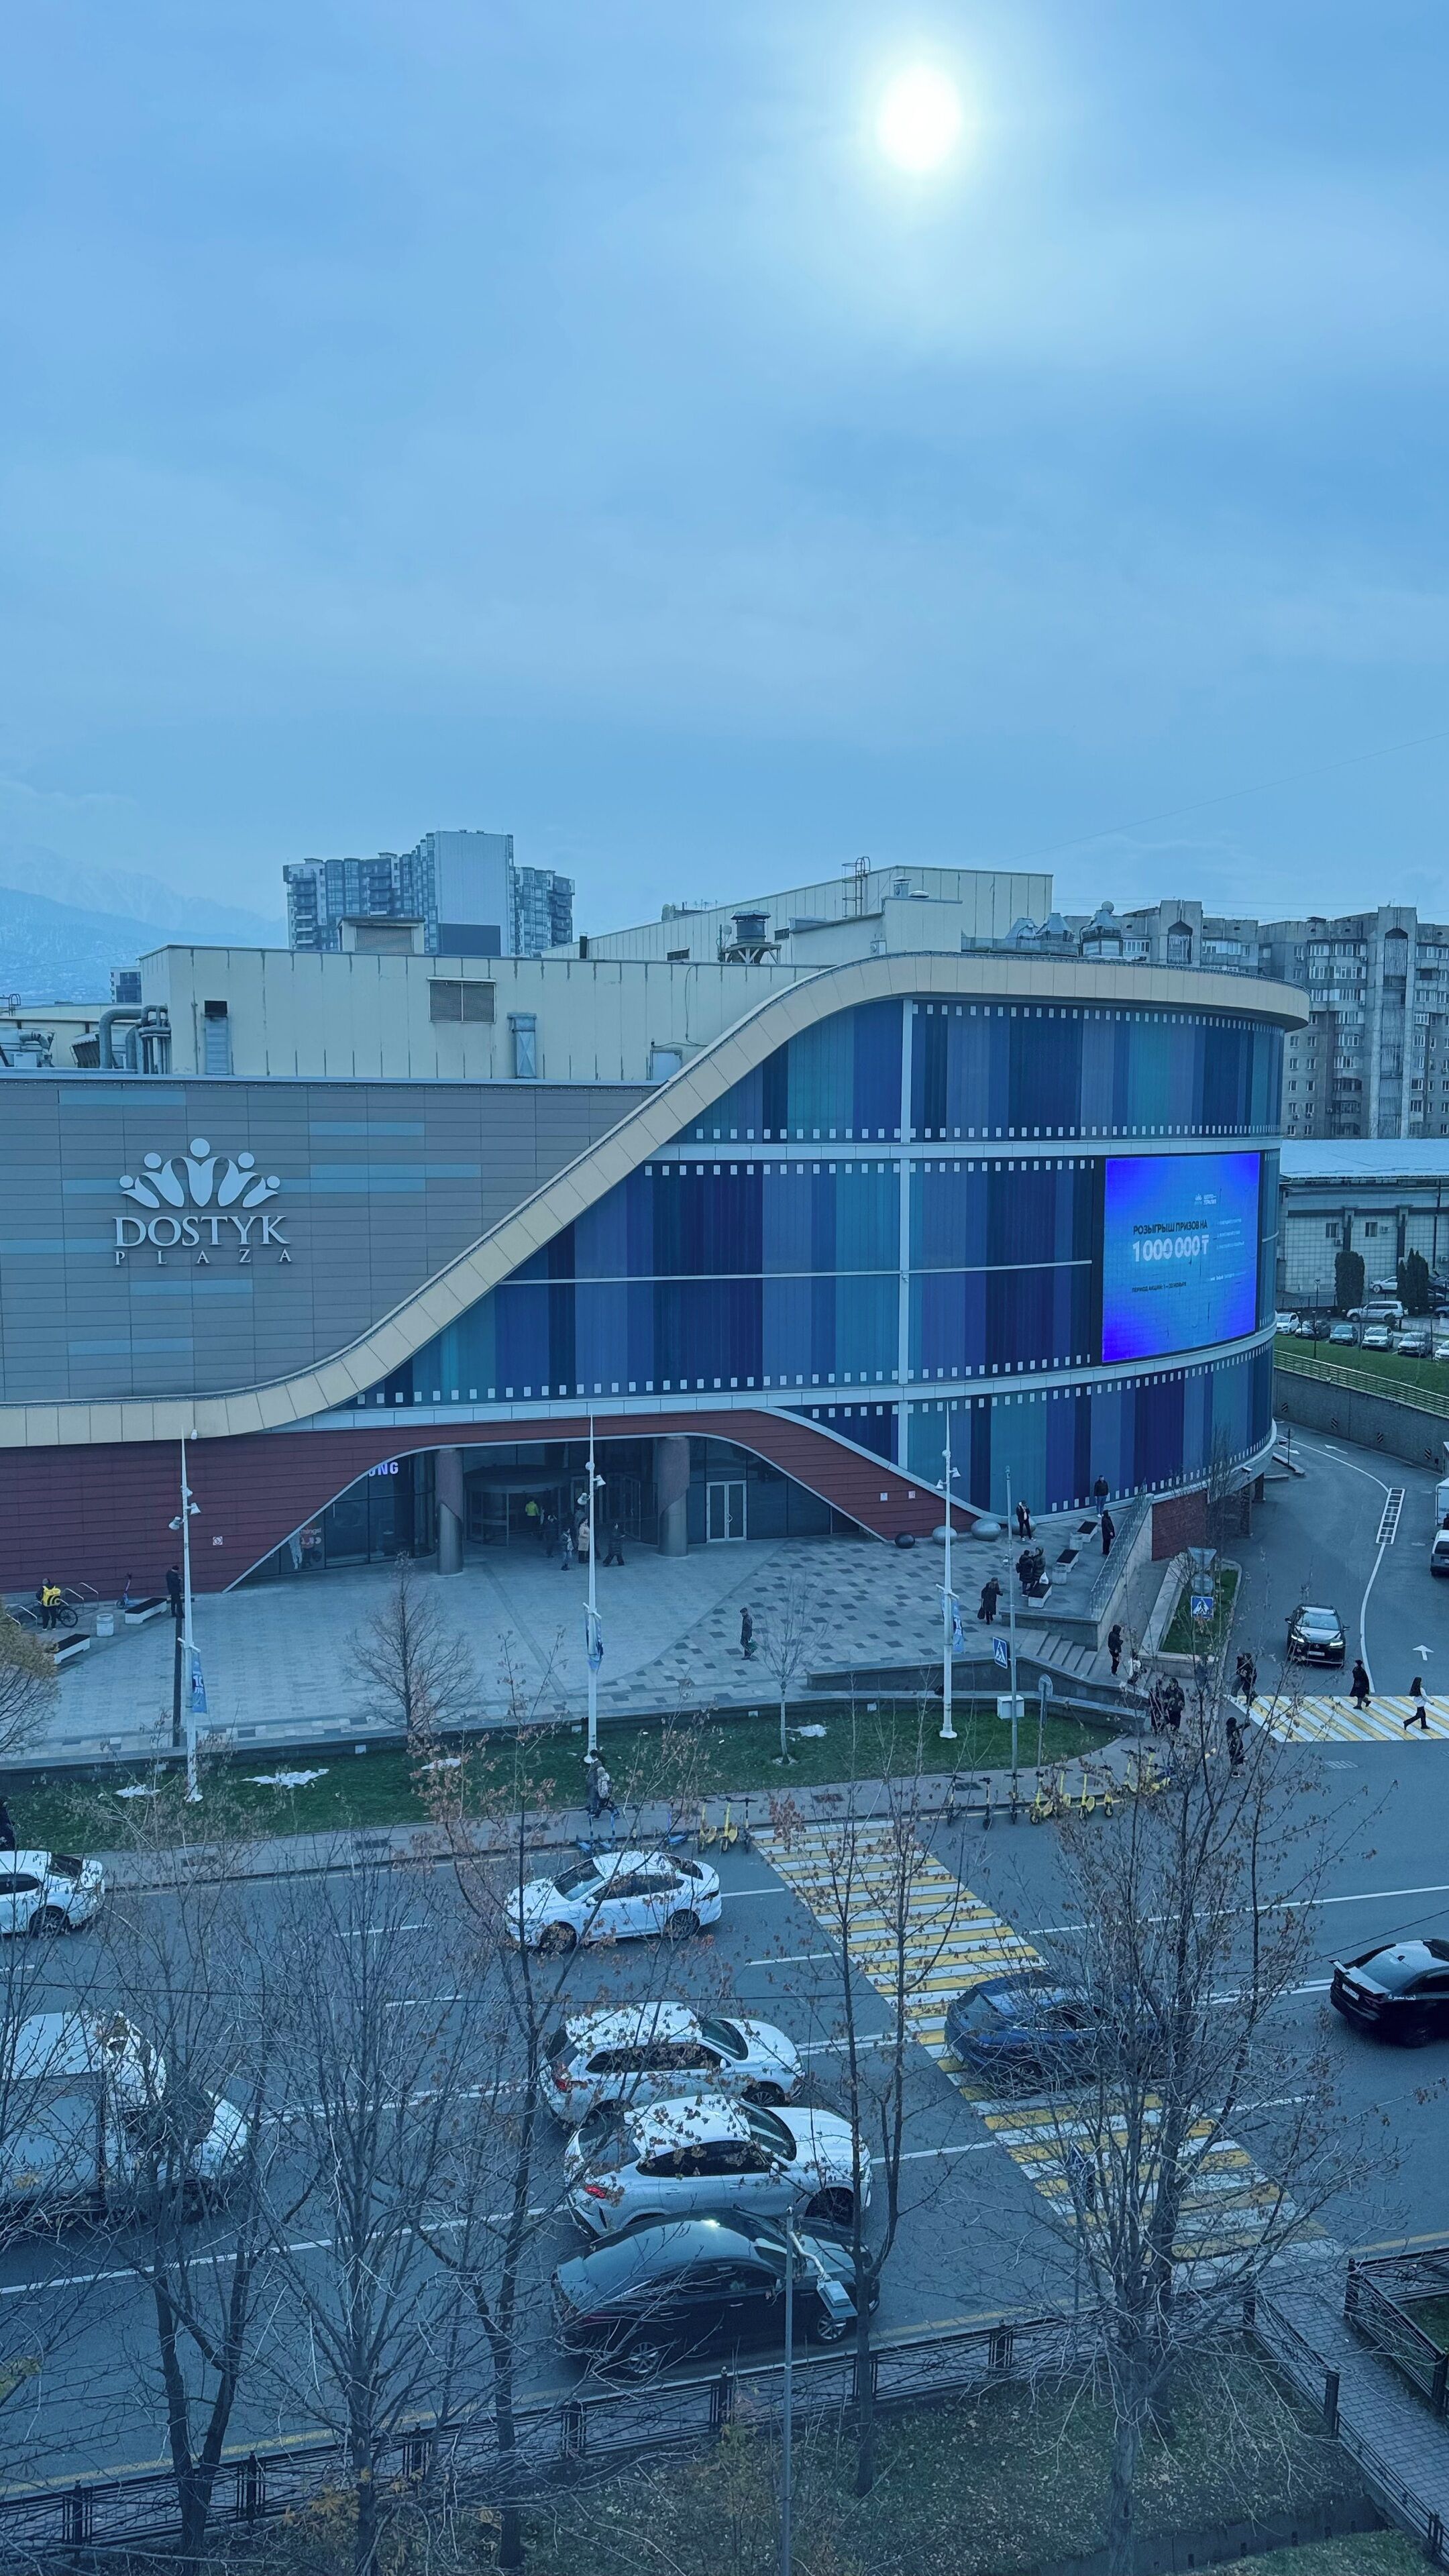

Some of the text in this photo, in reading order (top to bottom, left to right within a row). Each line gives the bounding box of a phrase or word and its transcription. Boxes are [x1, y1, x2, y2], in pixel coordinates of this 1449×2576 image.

[112, 1215, 290, 1247] DOSTYK
[1133, 1222, 1175, 1235] РОЗЫГРЫШ
[1175, 1220, 1199, 1232] ПРИЗОВ
[1199, 1219, 1208, 1230] НА
[114, 1248, 292, 1266] PLAZA
